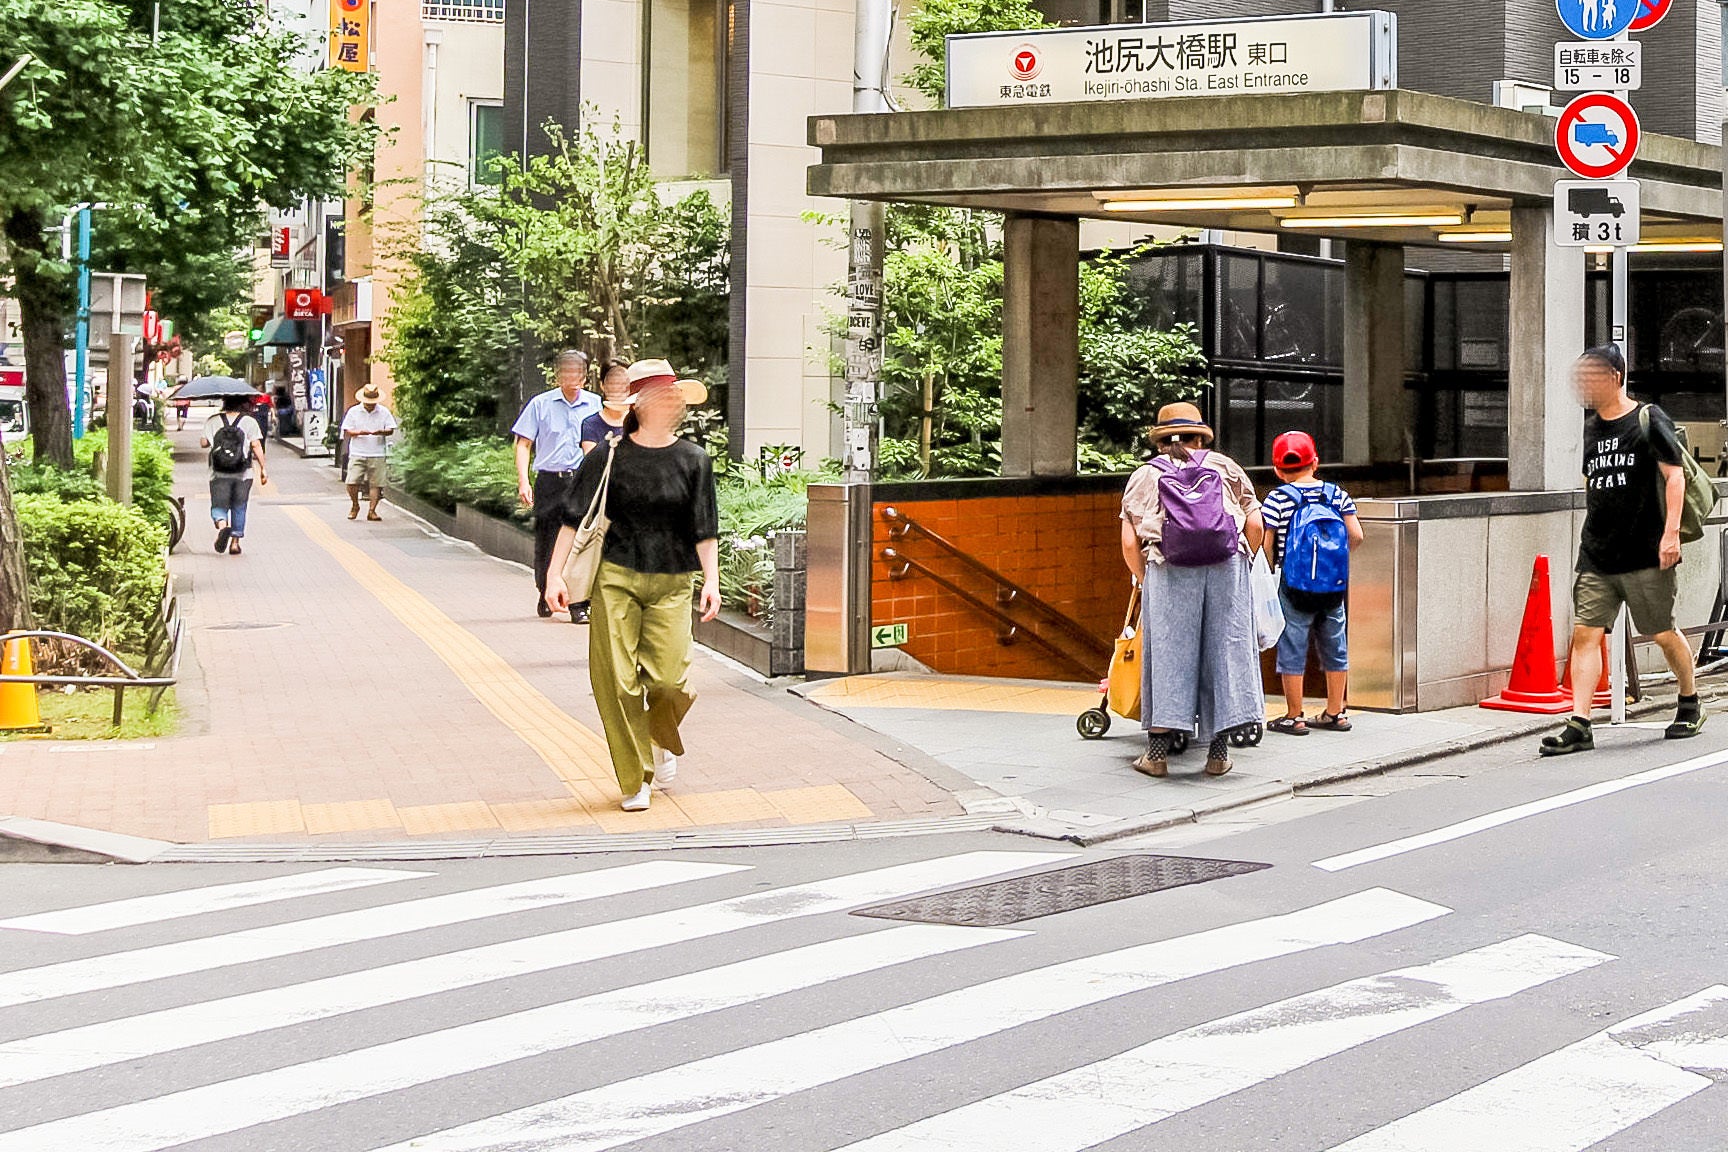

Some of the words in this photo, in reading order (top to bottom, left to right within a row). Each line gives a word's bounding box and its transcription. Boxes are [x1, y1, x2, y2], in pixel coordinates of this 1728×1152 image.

[338, 17, 361, 63] 松屋
[1084, 32, 1238, 74] 池尻大橋駅
[1247, 41, 1287, 66] 東口
[1560, 48, 1635, 65] 自転車を除く
[1174, 75, 1201, 91] Sta.
[1207, 73, 1240, 90] East
[1244, 71, 1309, 88] Entrance
[1564, 68, 1580, 85] 15
[1614, 67, 1630, 84] 18
[999, 83, 1052, 99] 東急電鉄
[1597, 437, 1619, 454] USA
